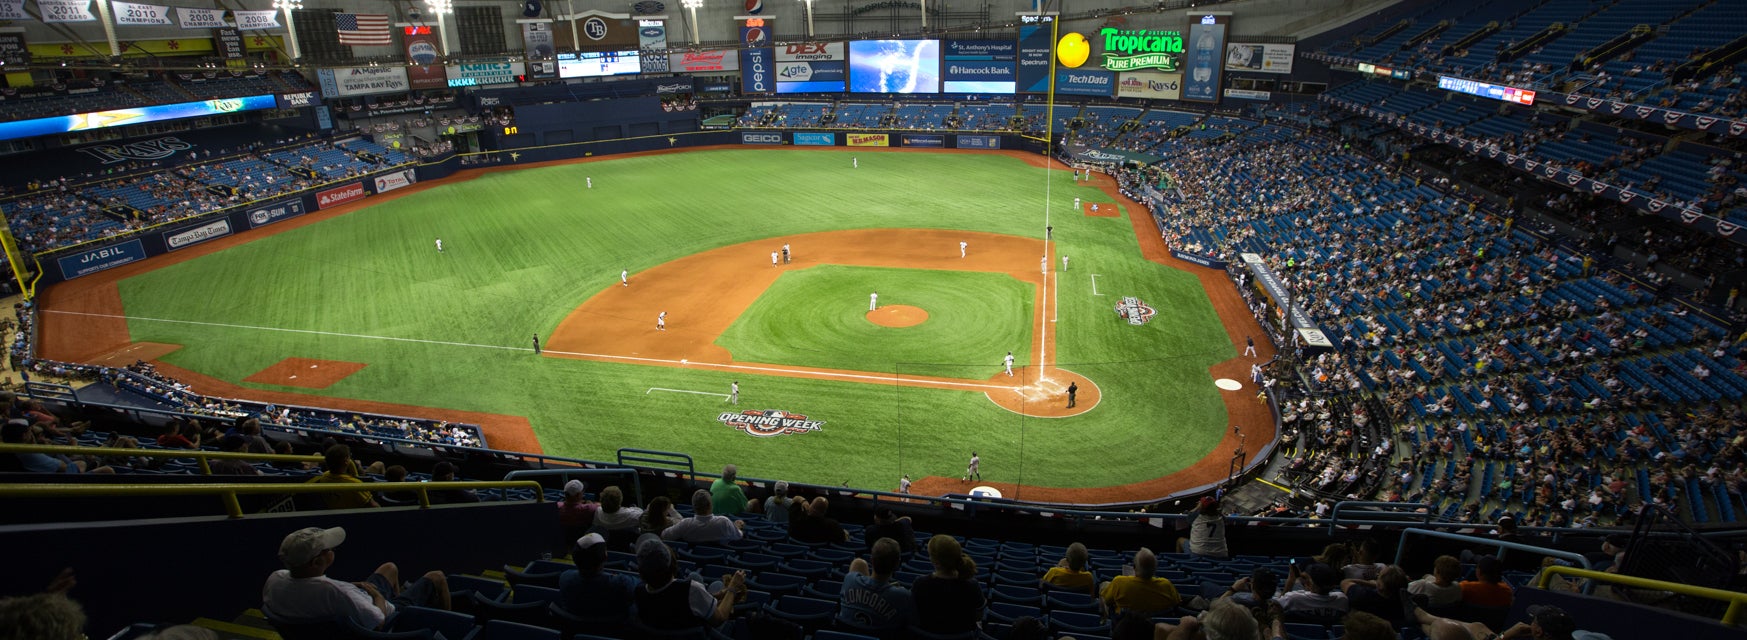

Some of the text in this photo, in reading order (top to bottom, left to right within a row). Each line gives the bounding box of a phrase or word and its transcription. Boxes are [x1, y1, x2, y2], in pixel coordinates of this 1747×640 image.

[53, 6, 80, 15] 2011
[127, 9, 157, 18] 2010
[1100, 27, 1183, 55] Tropicana
[0, 43, 18, 51] you
[786, 42, 828, 55] DEX
[966, 44, 990, 52] Anthony's
[991, 44, 1012, 52] Hospital
[641, 50, 668, 62] ROSE
[1106, 55, 1170, 68] PURE PREMIUM
[363, 67, 392, 75] Majestic
[750, 52, 766, 91] pepsi
[791, 66, 807, 76] gte
[958, 66, 1013, 74] Hancock Bank
[345, 83, 371, 91] TAMPA
[371, 81, 385, 89] BAY
[1170, 81, 1178, 90] 6
[283, 92, 314, 101] REPUBLIC
[290, 98, 309, 106] BANK
[744, 134, 781, 143] GEICO
[387, 178, 405, 187] TOTAL
[270, 207, 286, 218] SUN
[171, 224, 227, 245] Tampa Bay Times
[81, 247, 124, 263] JABIL
[77, 265, 100, 275] SUPPORTS
[109, 256, 134, 267] COMMUNITY
[719, 412, 828, 431] OPENING WEEK
[1206, 521, 1217, 538] 7
[843, 588, 897, 622] LONGORIA
